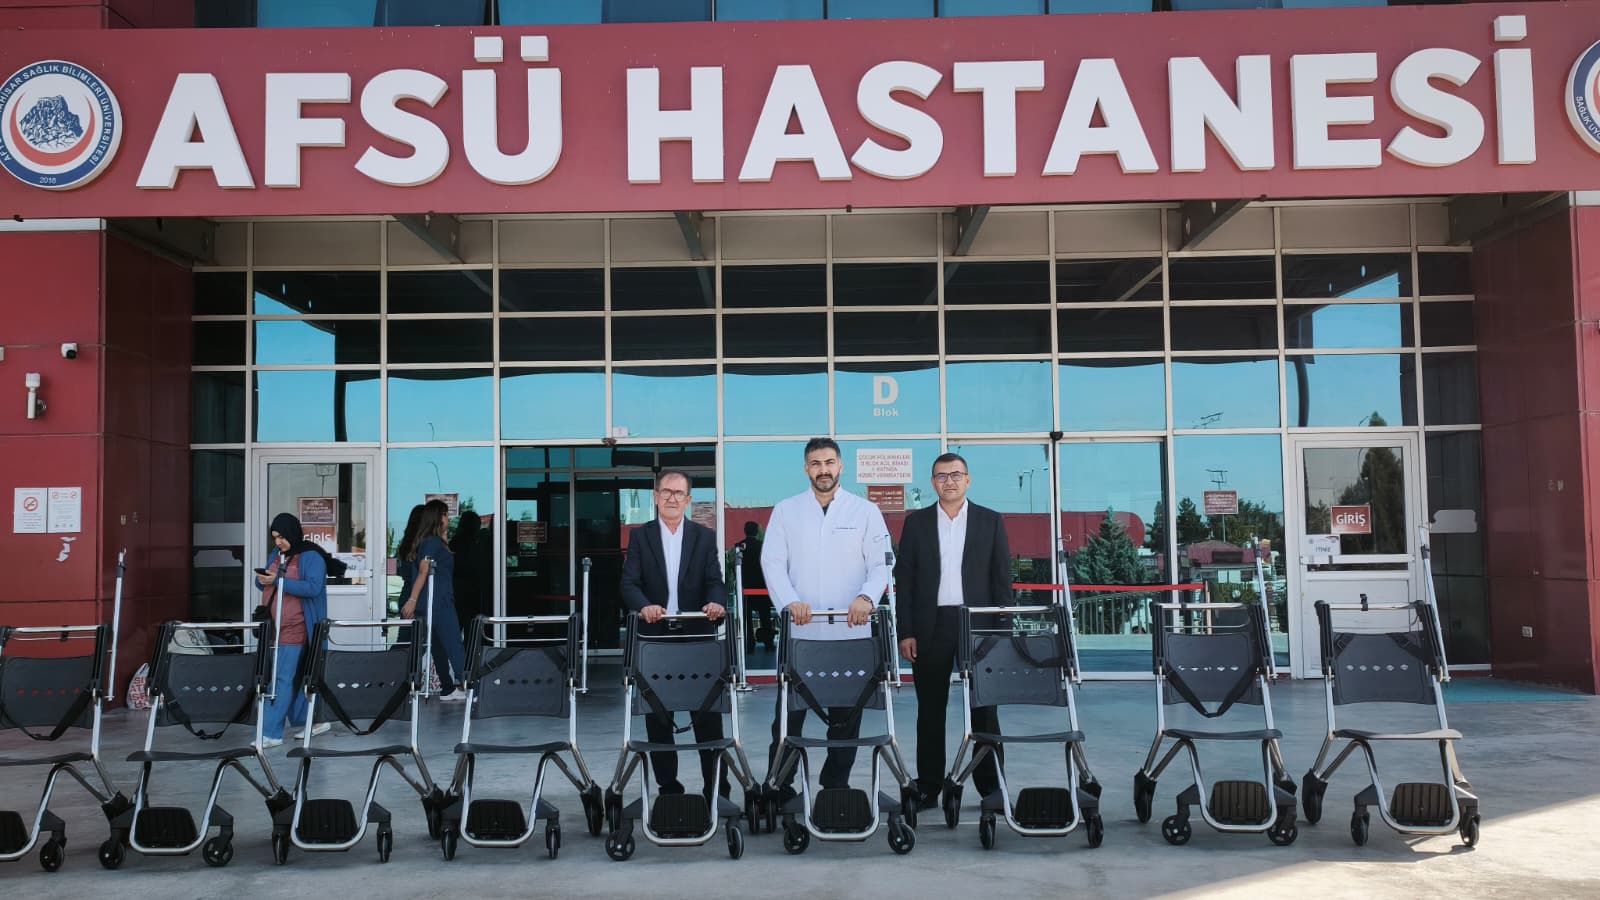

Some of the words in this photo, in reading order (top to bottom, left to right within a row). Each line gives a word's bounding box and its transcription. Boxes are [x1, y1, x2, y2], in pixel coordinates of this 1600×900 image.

[136, 35, 563, 189] AFSÜ
[626, 15, 1537, 184] HASTANESİ
[22, 65, 59, 80] SAĞLIK
[62, 65, 105, 98] BİLİMLERİ
[89, 97, 112, 166] ÜNİVERSİTESİ
[39, 176, 57, 184] 2018
[873, 375, 899, 405] D
[873, 407, 899, 417] Blok
[1336, 512, 1366, 527] GİRİŞ
